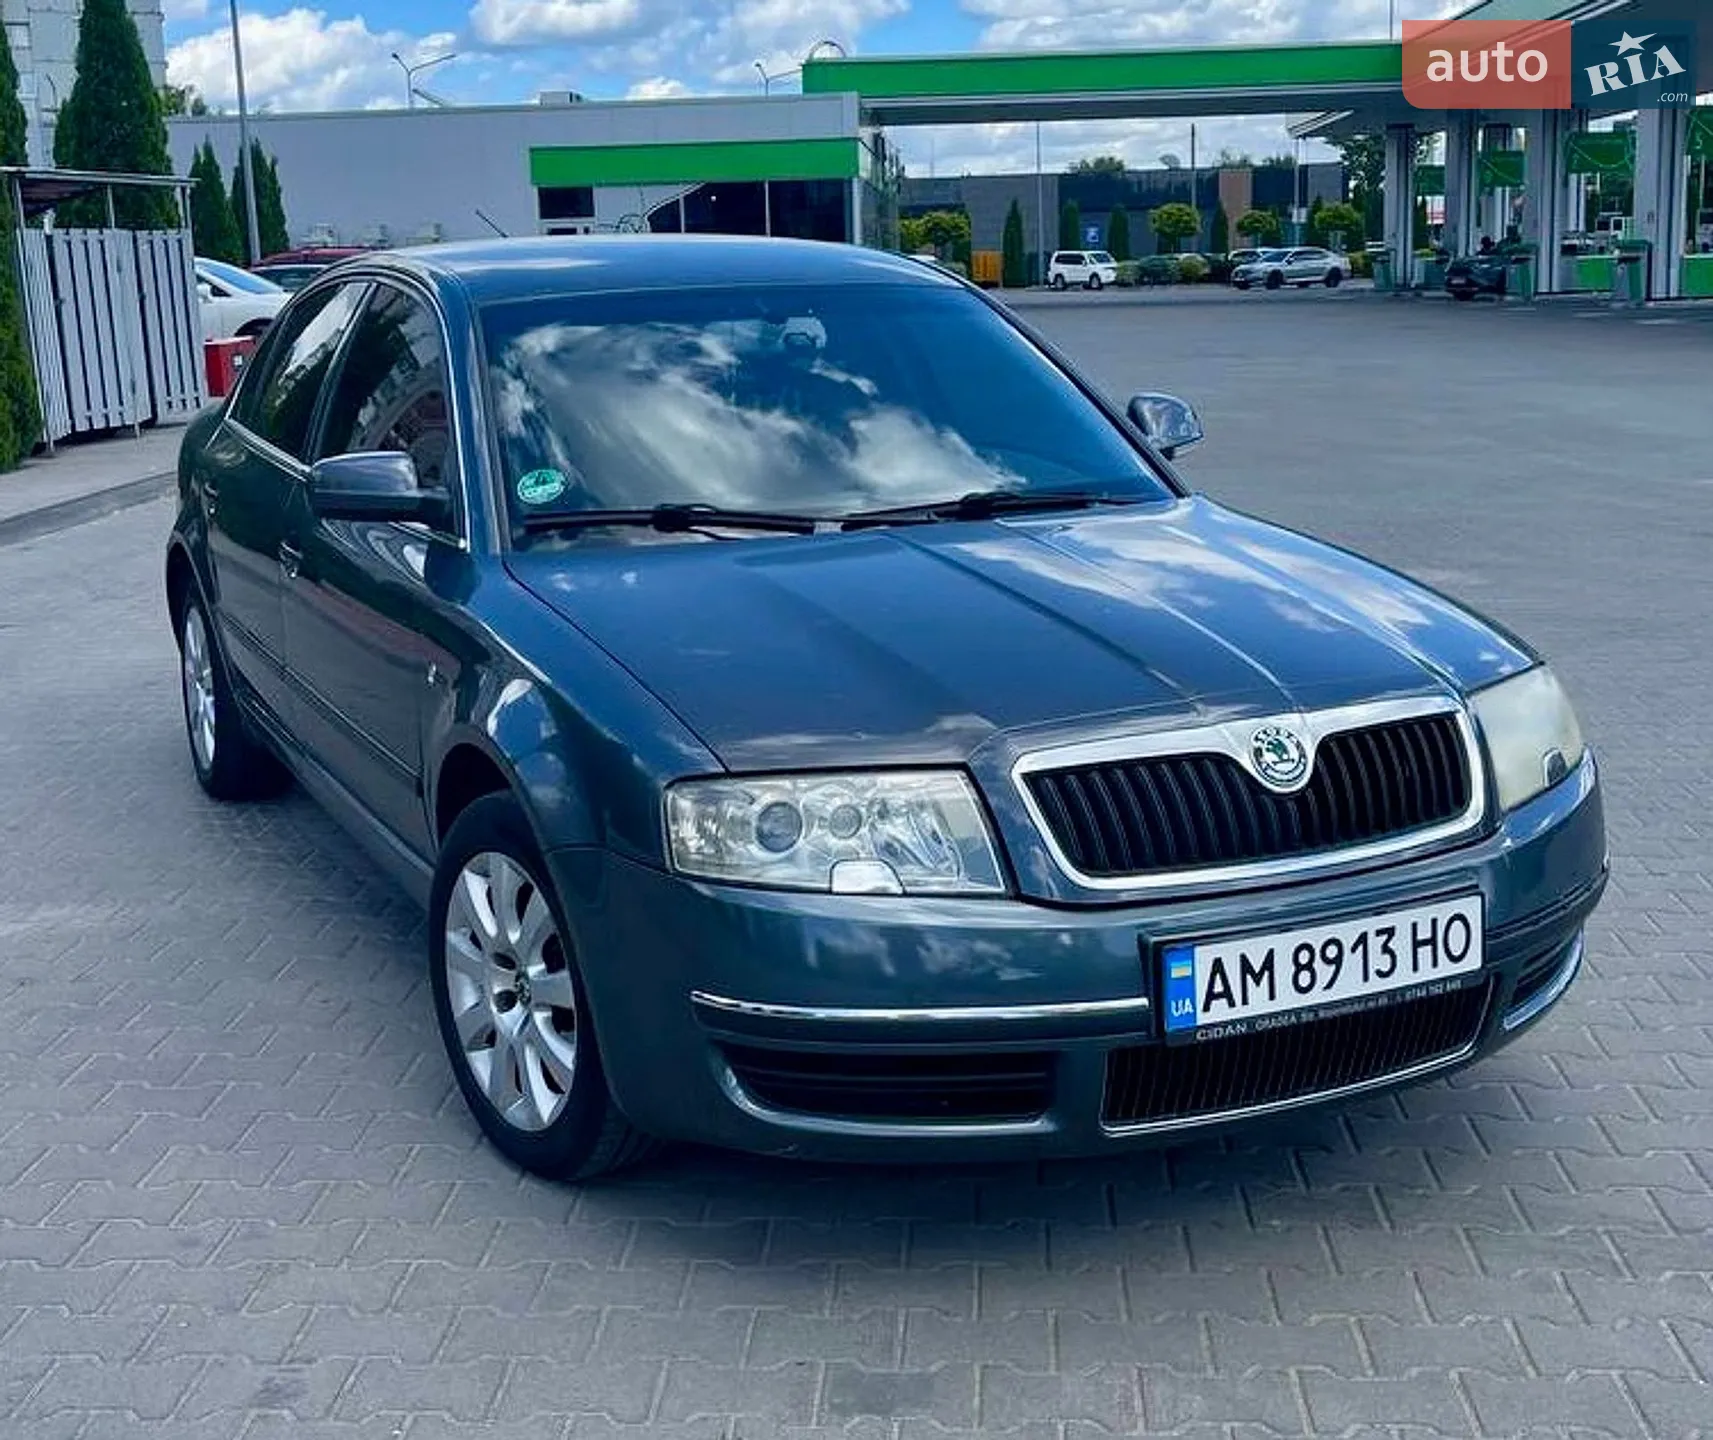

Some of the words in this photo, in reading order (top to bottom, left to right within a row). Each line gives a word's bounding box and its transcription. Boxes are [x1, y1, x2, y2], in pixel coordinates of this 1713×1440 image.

[1202, 949, 1276, 1013] AM
[1290, 926, 1398, 995] 8913
[1411, 912, 1472, 973] HO
[1171, 999, 1194, 1017] UA
